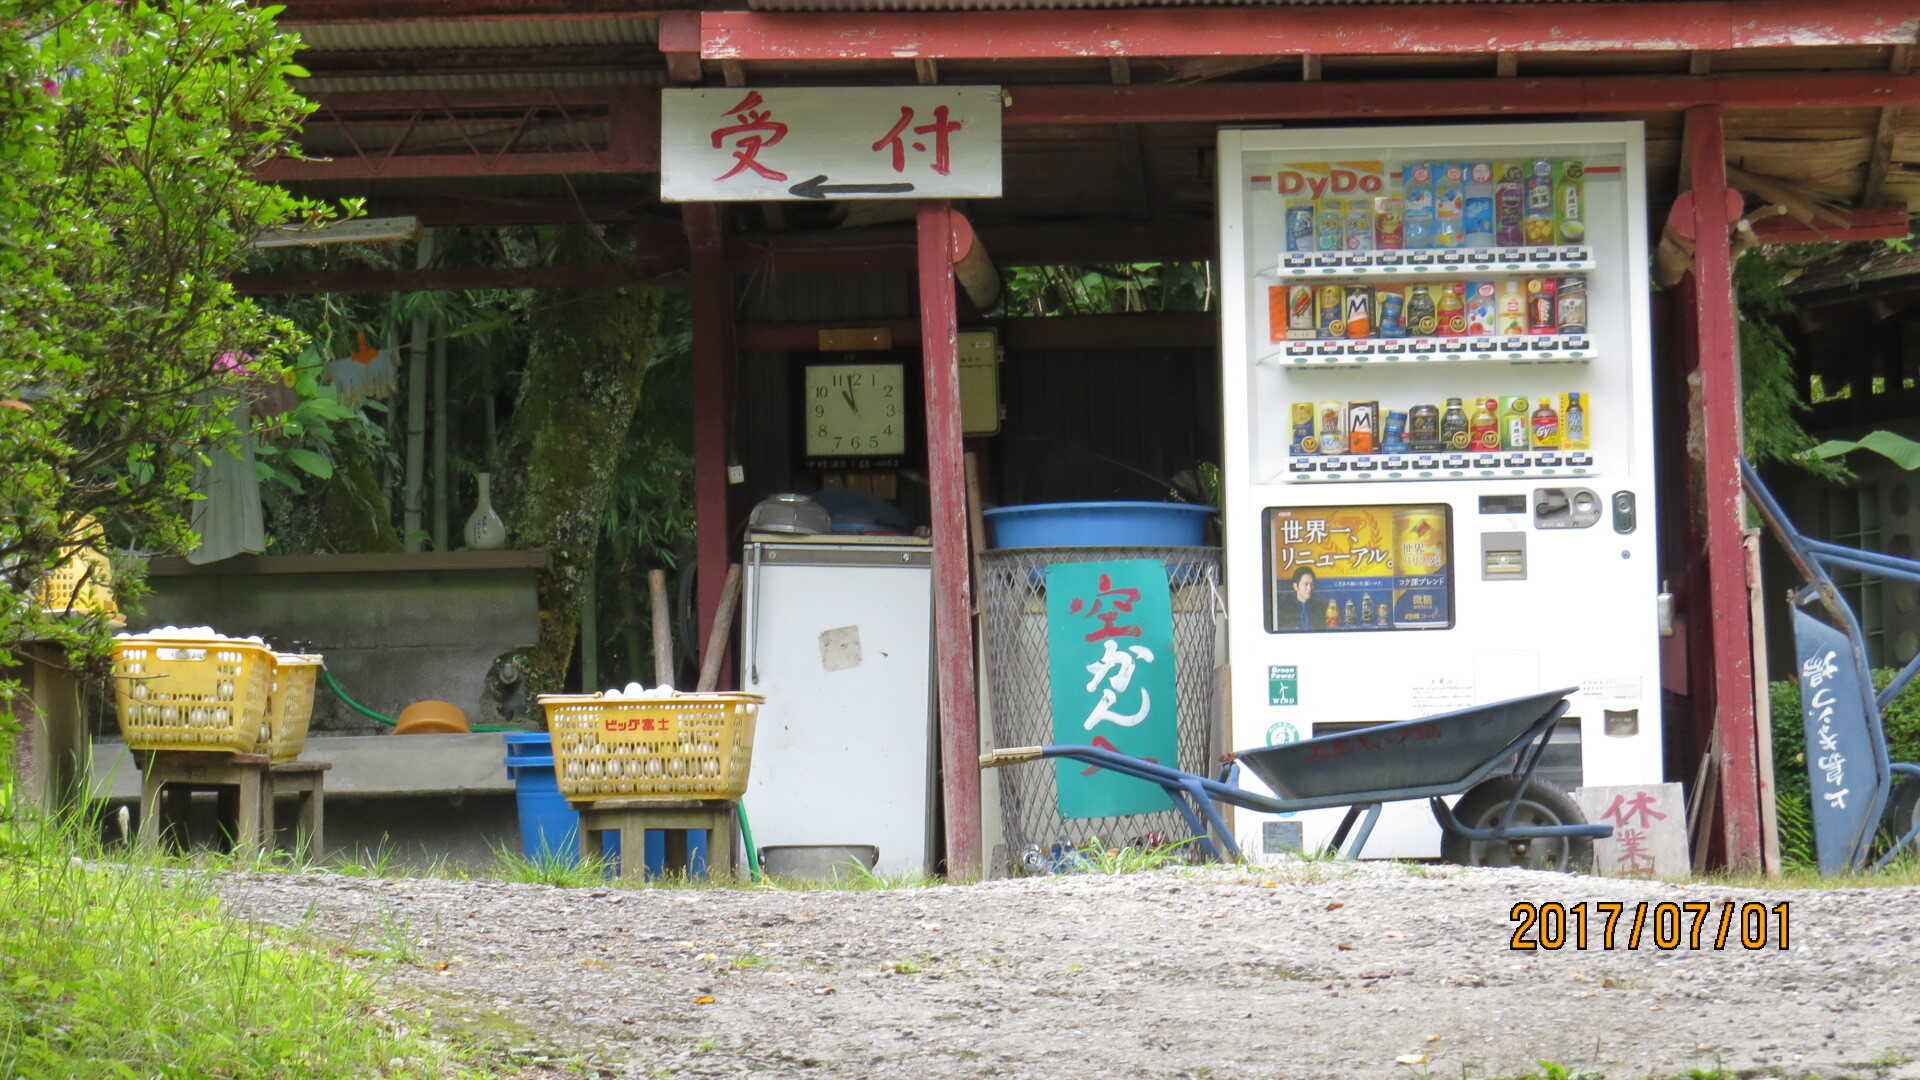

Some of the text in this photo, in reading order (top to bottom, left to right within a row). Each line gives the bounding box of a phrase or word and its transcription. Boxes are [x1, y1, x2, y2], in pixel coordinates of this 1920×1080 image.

[711, 90, 962, 182] 受付
[1278, 170, 1384, 200] DyDo
[883, 385, 894, 398] 2
[833, 436, 843, 449] 7
[851, 437, 860, 449] 6
[869, 436, 879, 449] 5
[1280, 518, 1360, 545] 世界一、
